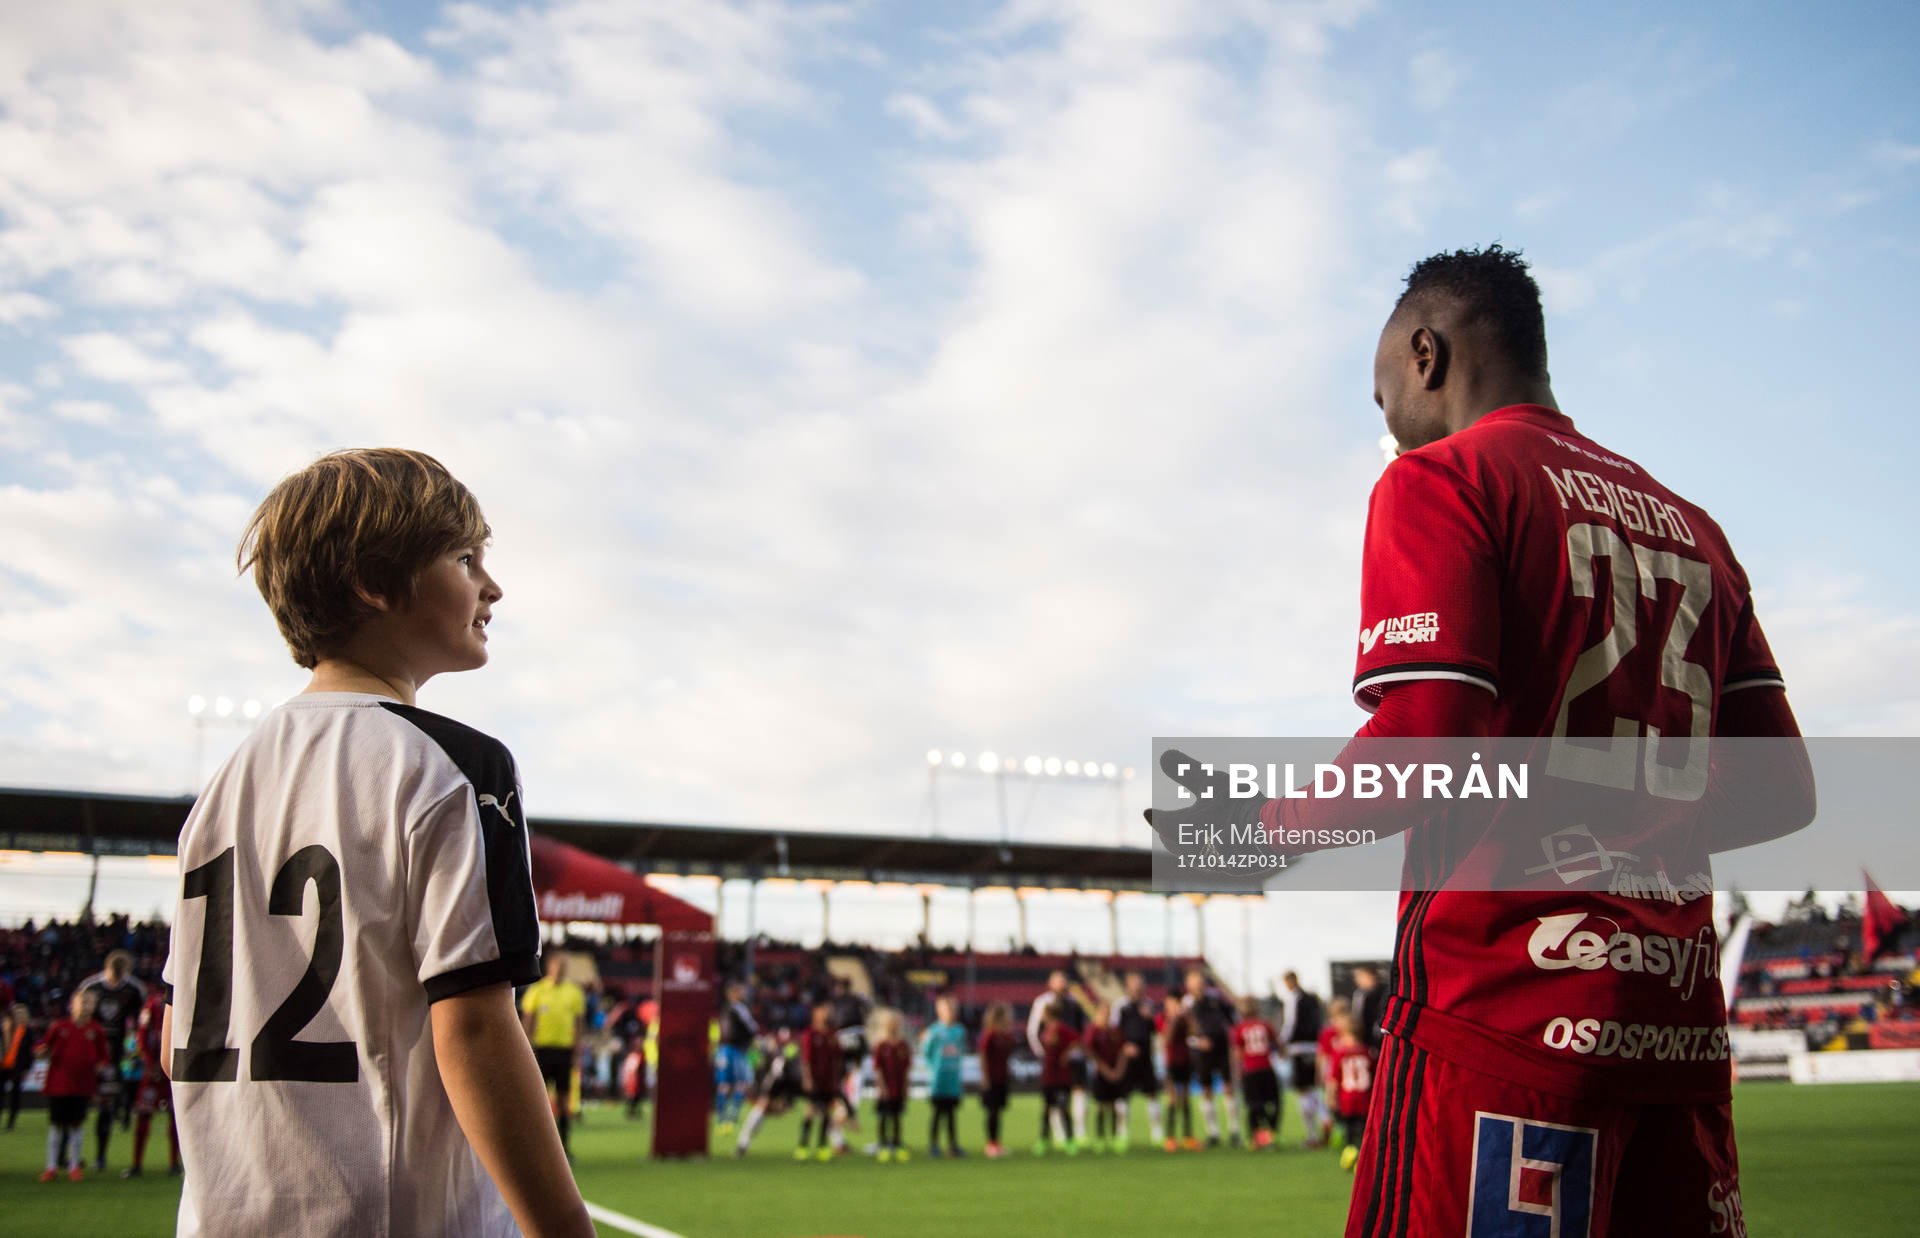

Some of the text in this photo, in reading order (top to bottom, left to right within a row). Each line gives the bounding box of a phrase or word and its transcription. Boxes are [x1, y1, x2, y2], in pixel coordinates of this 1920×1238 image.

[1542, 464, 1697, 547] MENSIRO
[1384, 627, 1440, 645] SPORT
[1386, 612, 1438, 632] INTER
[1544, 522, 1713, 802] 23
[172, 844, 359, 1082] 12
[1543, 1016, 1728, 1062] OSDSPORT.SE
